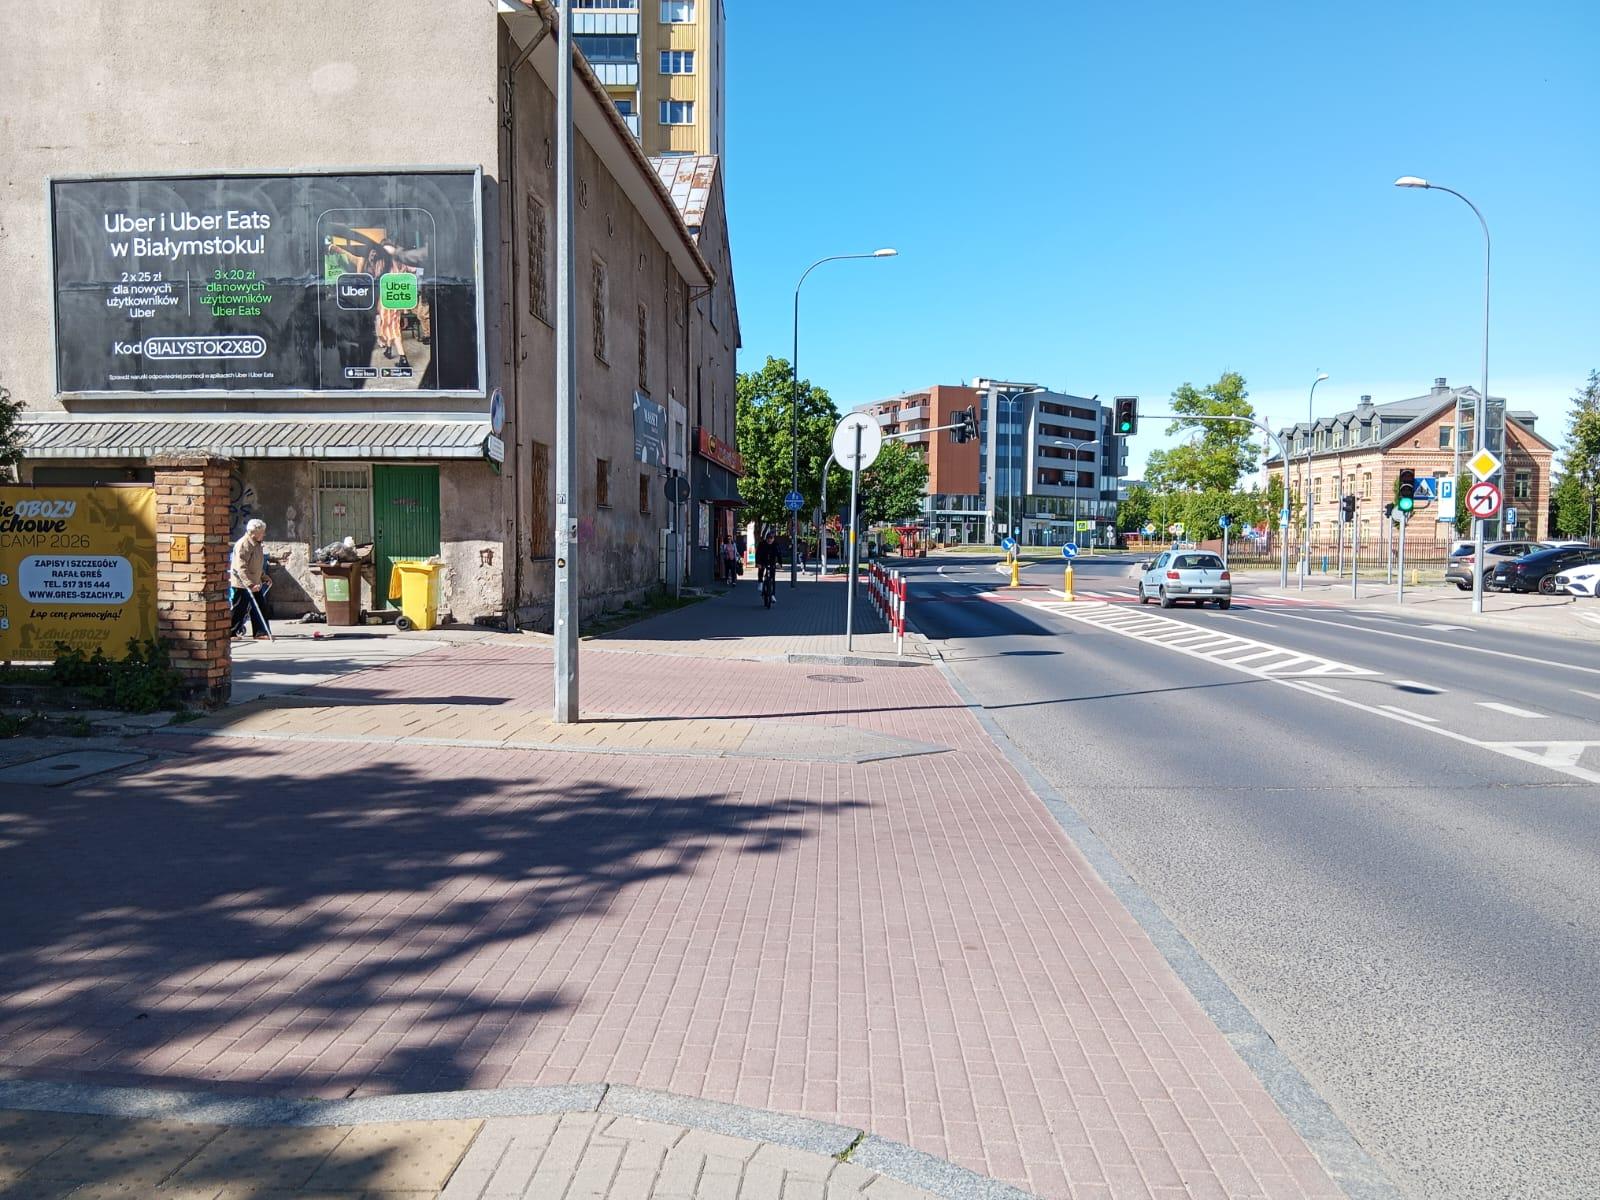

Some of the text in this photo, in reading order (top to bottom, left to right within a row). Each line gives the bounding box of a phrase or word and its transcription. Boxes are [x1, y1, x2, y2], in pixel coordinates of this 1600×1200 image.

[105, 210, 271, 232] Uber i Uber Eats
[111, 235, 265, 260] w Białymstoku!
[138, 272, 151, 282] 25
[153, 272, 162, 281] zł
[231, 270, 244, 279] 20
[247, 269, 256, 279] zł
[113, 284, 172, 296] dla nowych
[207, 281, 264, 293] dla nowych
[342, 286, 368, 296] Uber
[386, 282, 410, 291] Uber
[107, 295, 179, 308] użytkowników
[386, 292, 411, 301] Eats
[130, 308, 155, 317] Uber
[212, 305, 261, 316] Uber Eats
[114, 341, 262, 354] Kod BIALYSTOK2X80
[1443, 483, 1450, 496] P
[16, 500, 76, 518] OBOZY
[0, 534, 90, 548] CAMP 2026
[71, 558, 118, 567] SZCZEGÓŁY
[52, 569, 102, 578] RAFAŁ GREŚ
[29, 591, 125, 599] WWW.GRES-SZACHY.PL
[30, 608, 123, 621] Łap cenę promocyjną!
